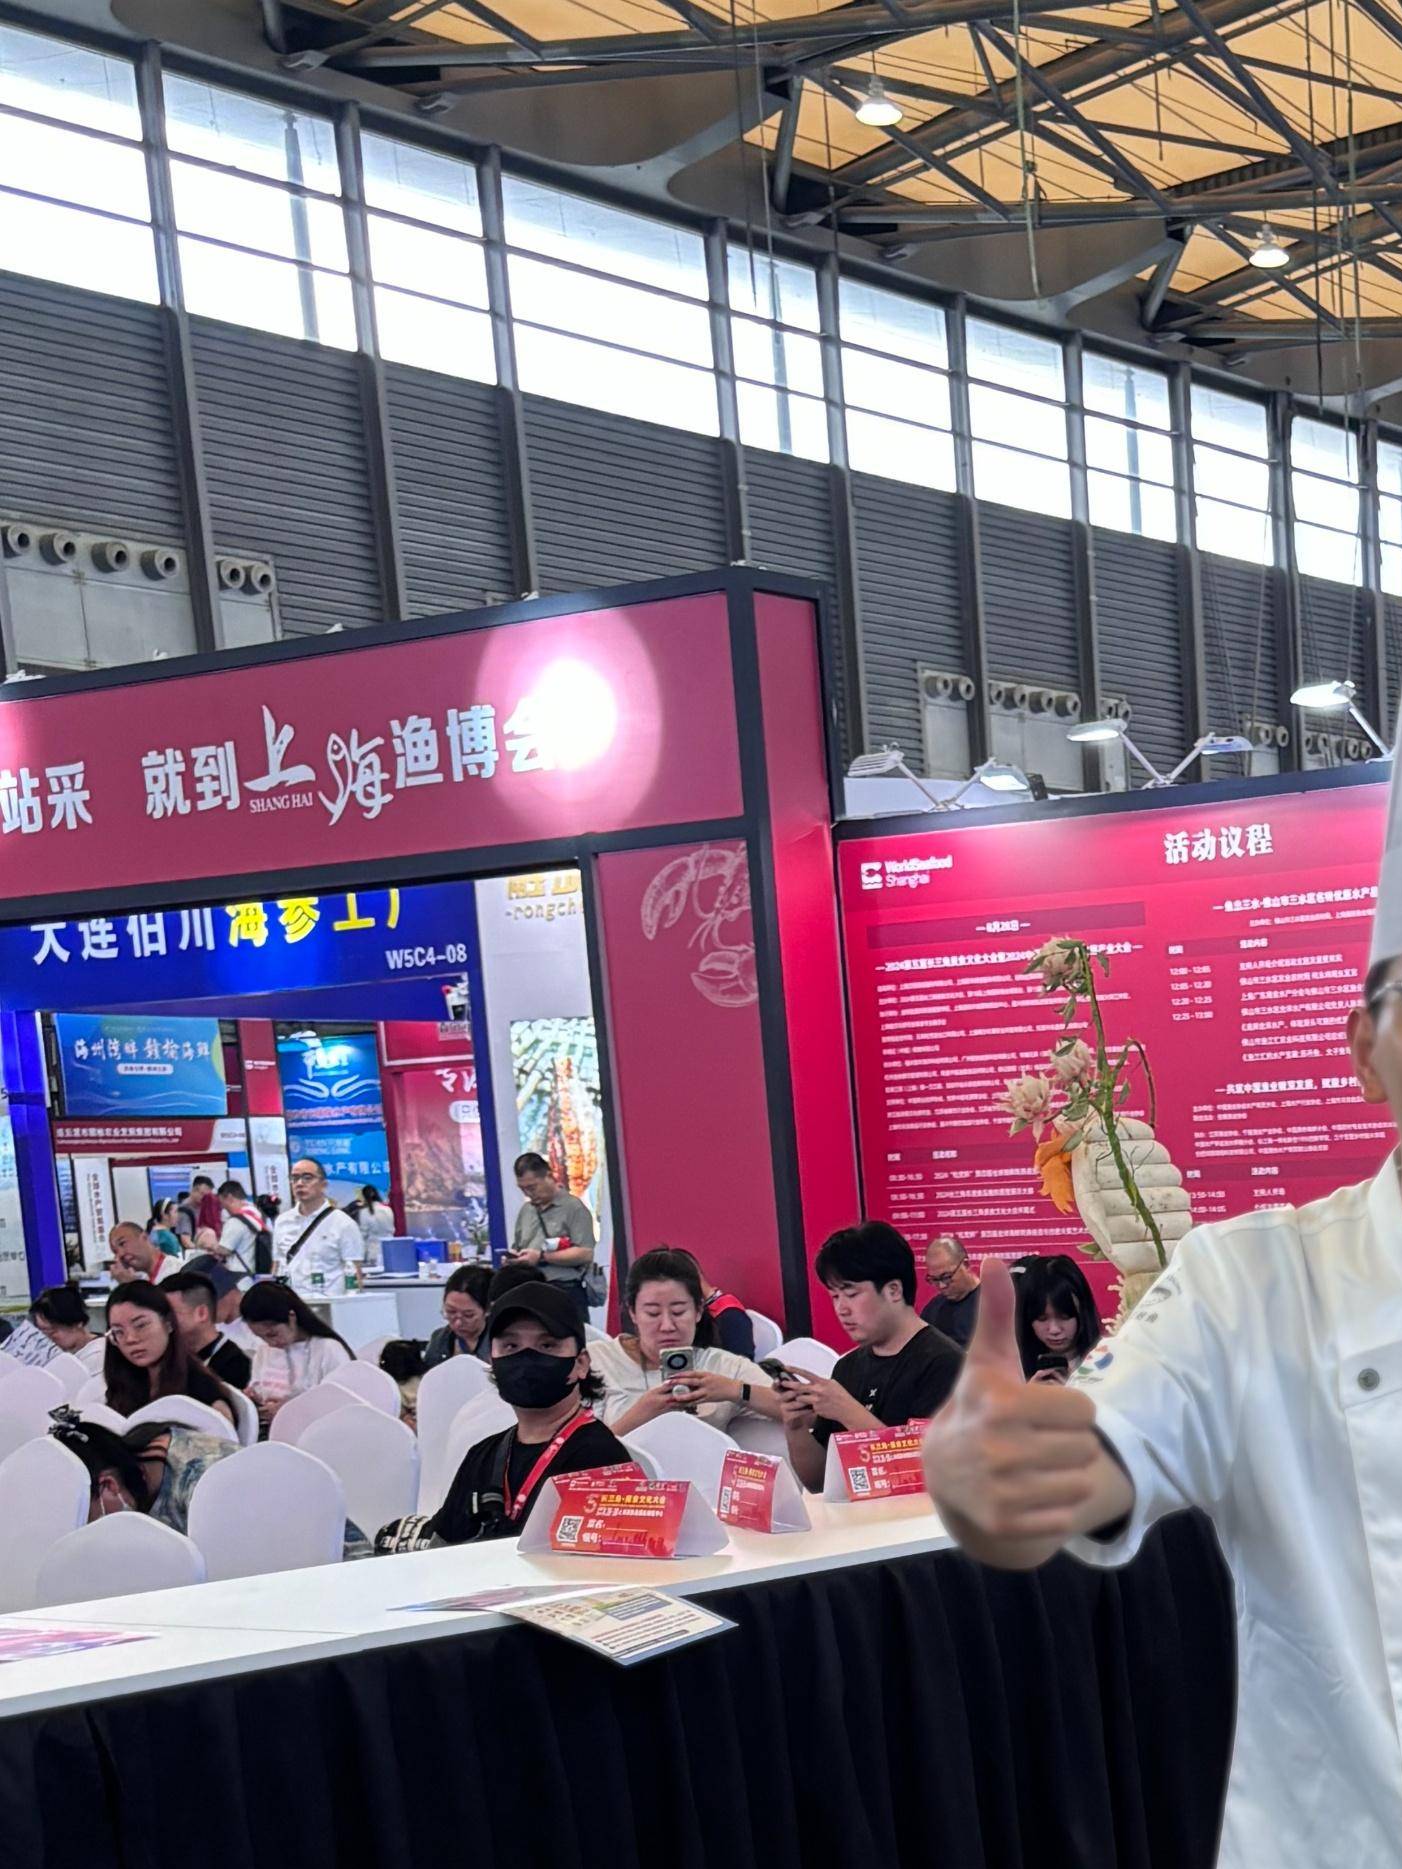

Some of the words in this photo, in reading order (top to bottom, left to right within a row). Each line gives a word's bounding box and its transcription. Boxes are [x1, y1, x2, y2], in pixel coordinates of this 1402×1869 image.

[250, 795, 290, 813] SHANG
[291, 793, 313, 808] HAI
[1164, 823, 1274, 865] 活动议程
[386, 943, 468, 970] W5C4-08
